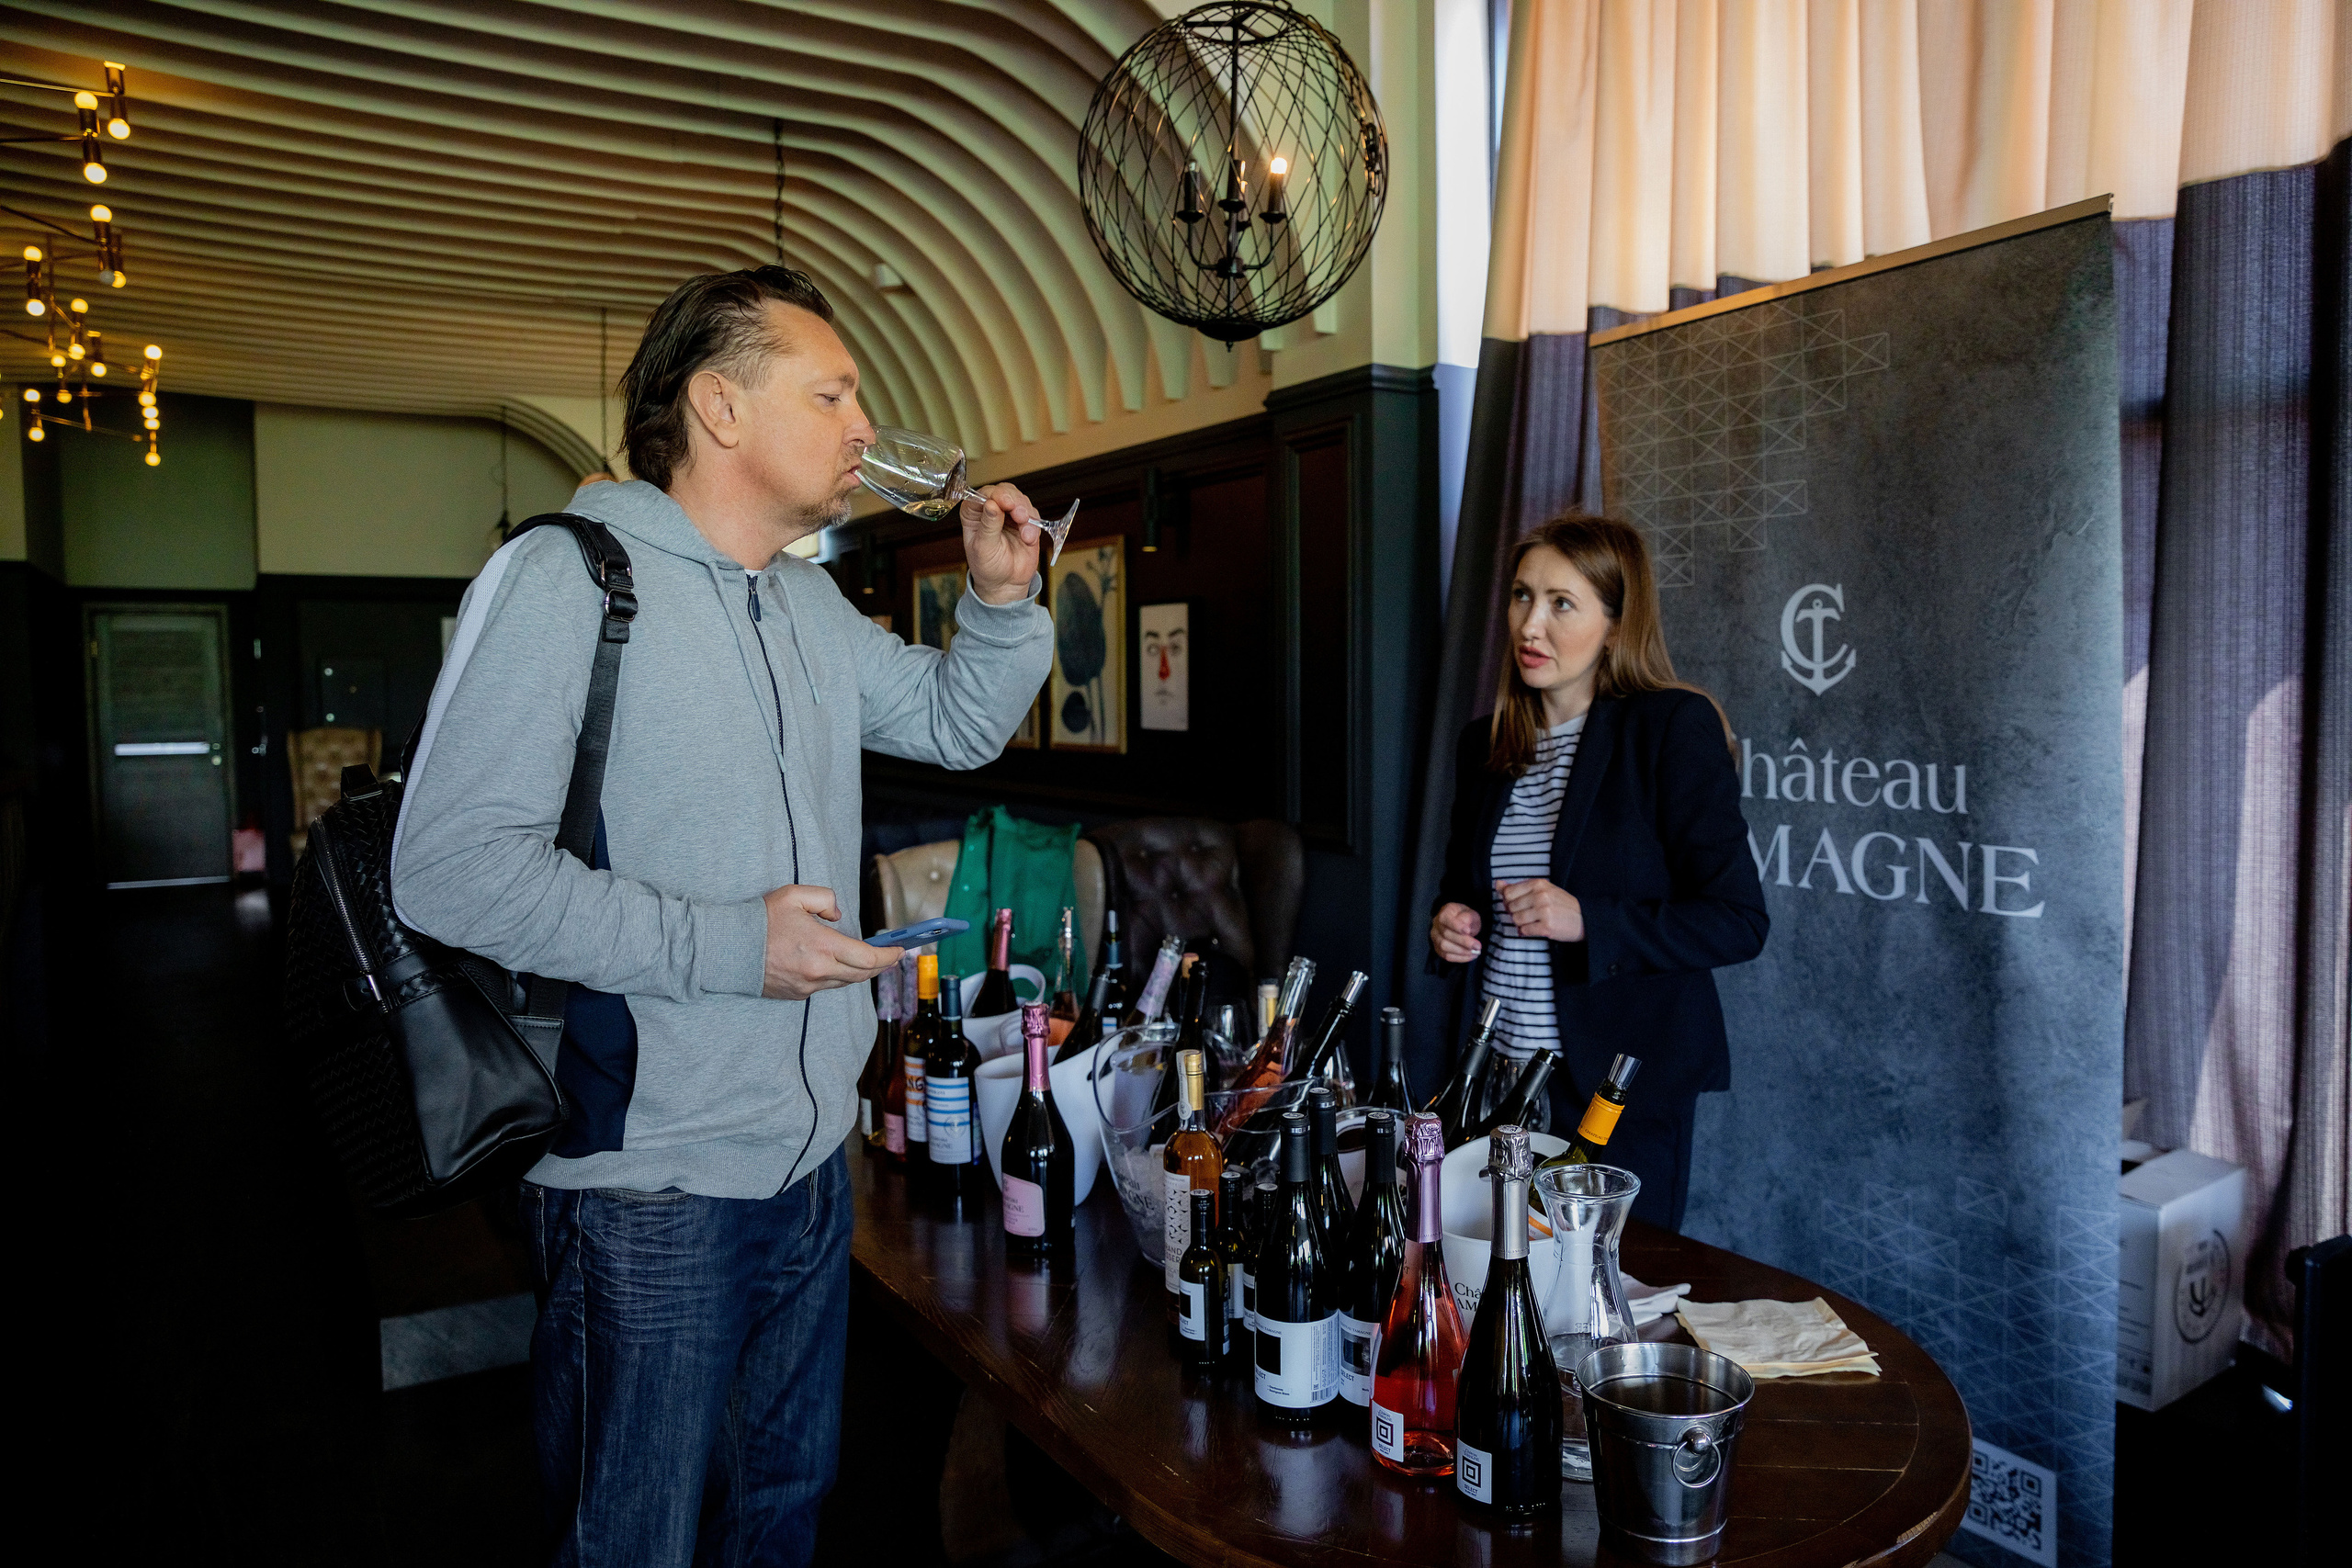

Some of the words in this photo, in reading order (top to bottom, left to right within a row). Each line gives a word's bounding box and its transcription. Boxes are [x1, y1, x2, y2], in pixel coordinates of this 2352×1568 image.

[1740, 736, 1969, 815] hâteau
[1747, 824, 2045, 918] MAGNE
[1454, 1281, 1482, 1300] Châ
[1457, 1297, 1477, 1313] AM
